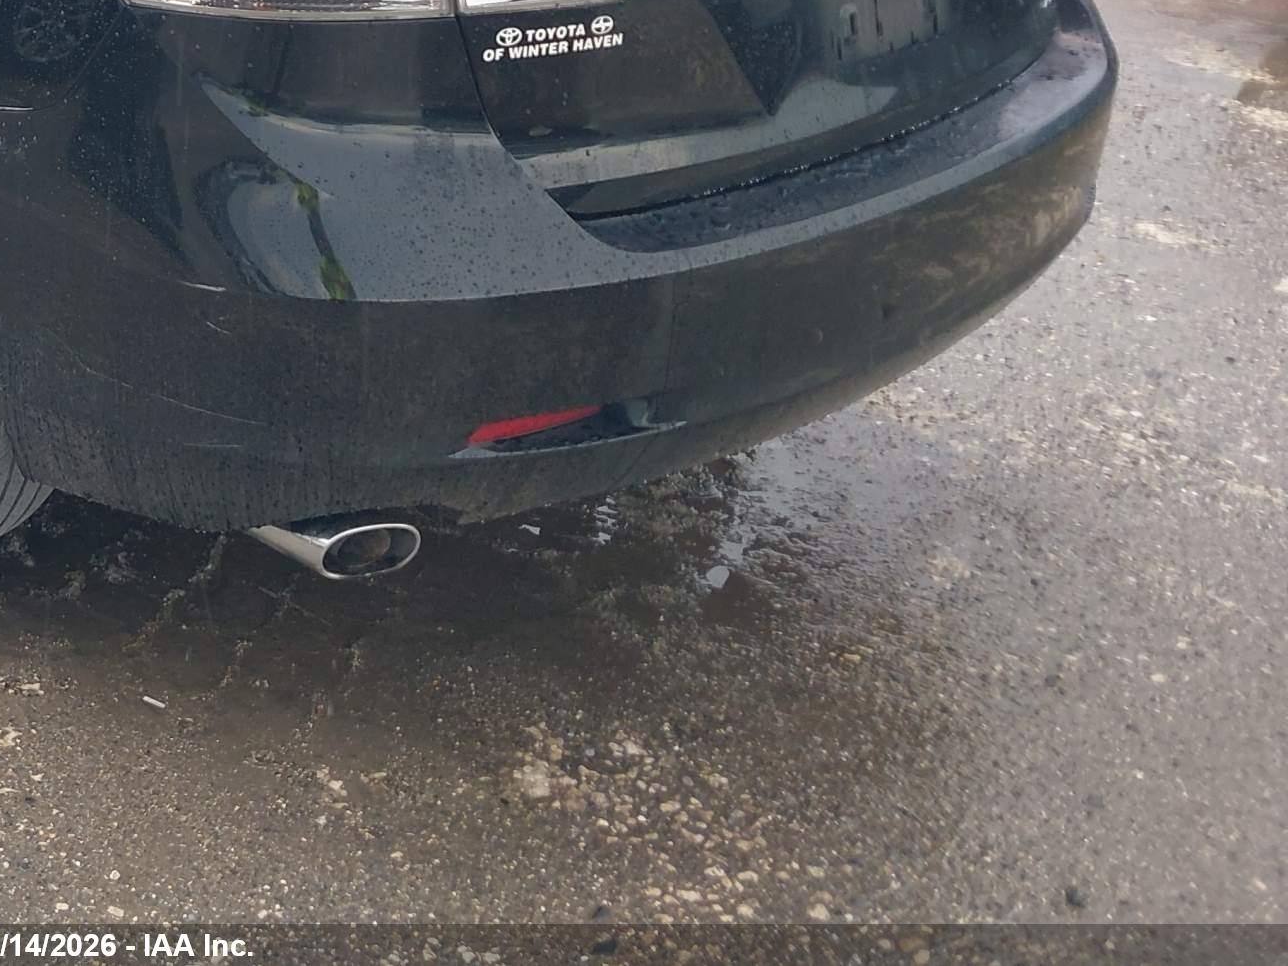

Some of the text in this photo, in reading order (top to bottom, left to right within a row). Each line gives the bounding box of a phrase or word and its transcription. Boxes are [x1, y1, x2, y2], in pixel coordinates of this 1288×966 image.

[526, 23, 586, 43] TOYOTA
[482, 33, 623, 62] OF WINTER HAVEN
